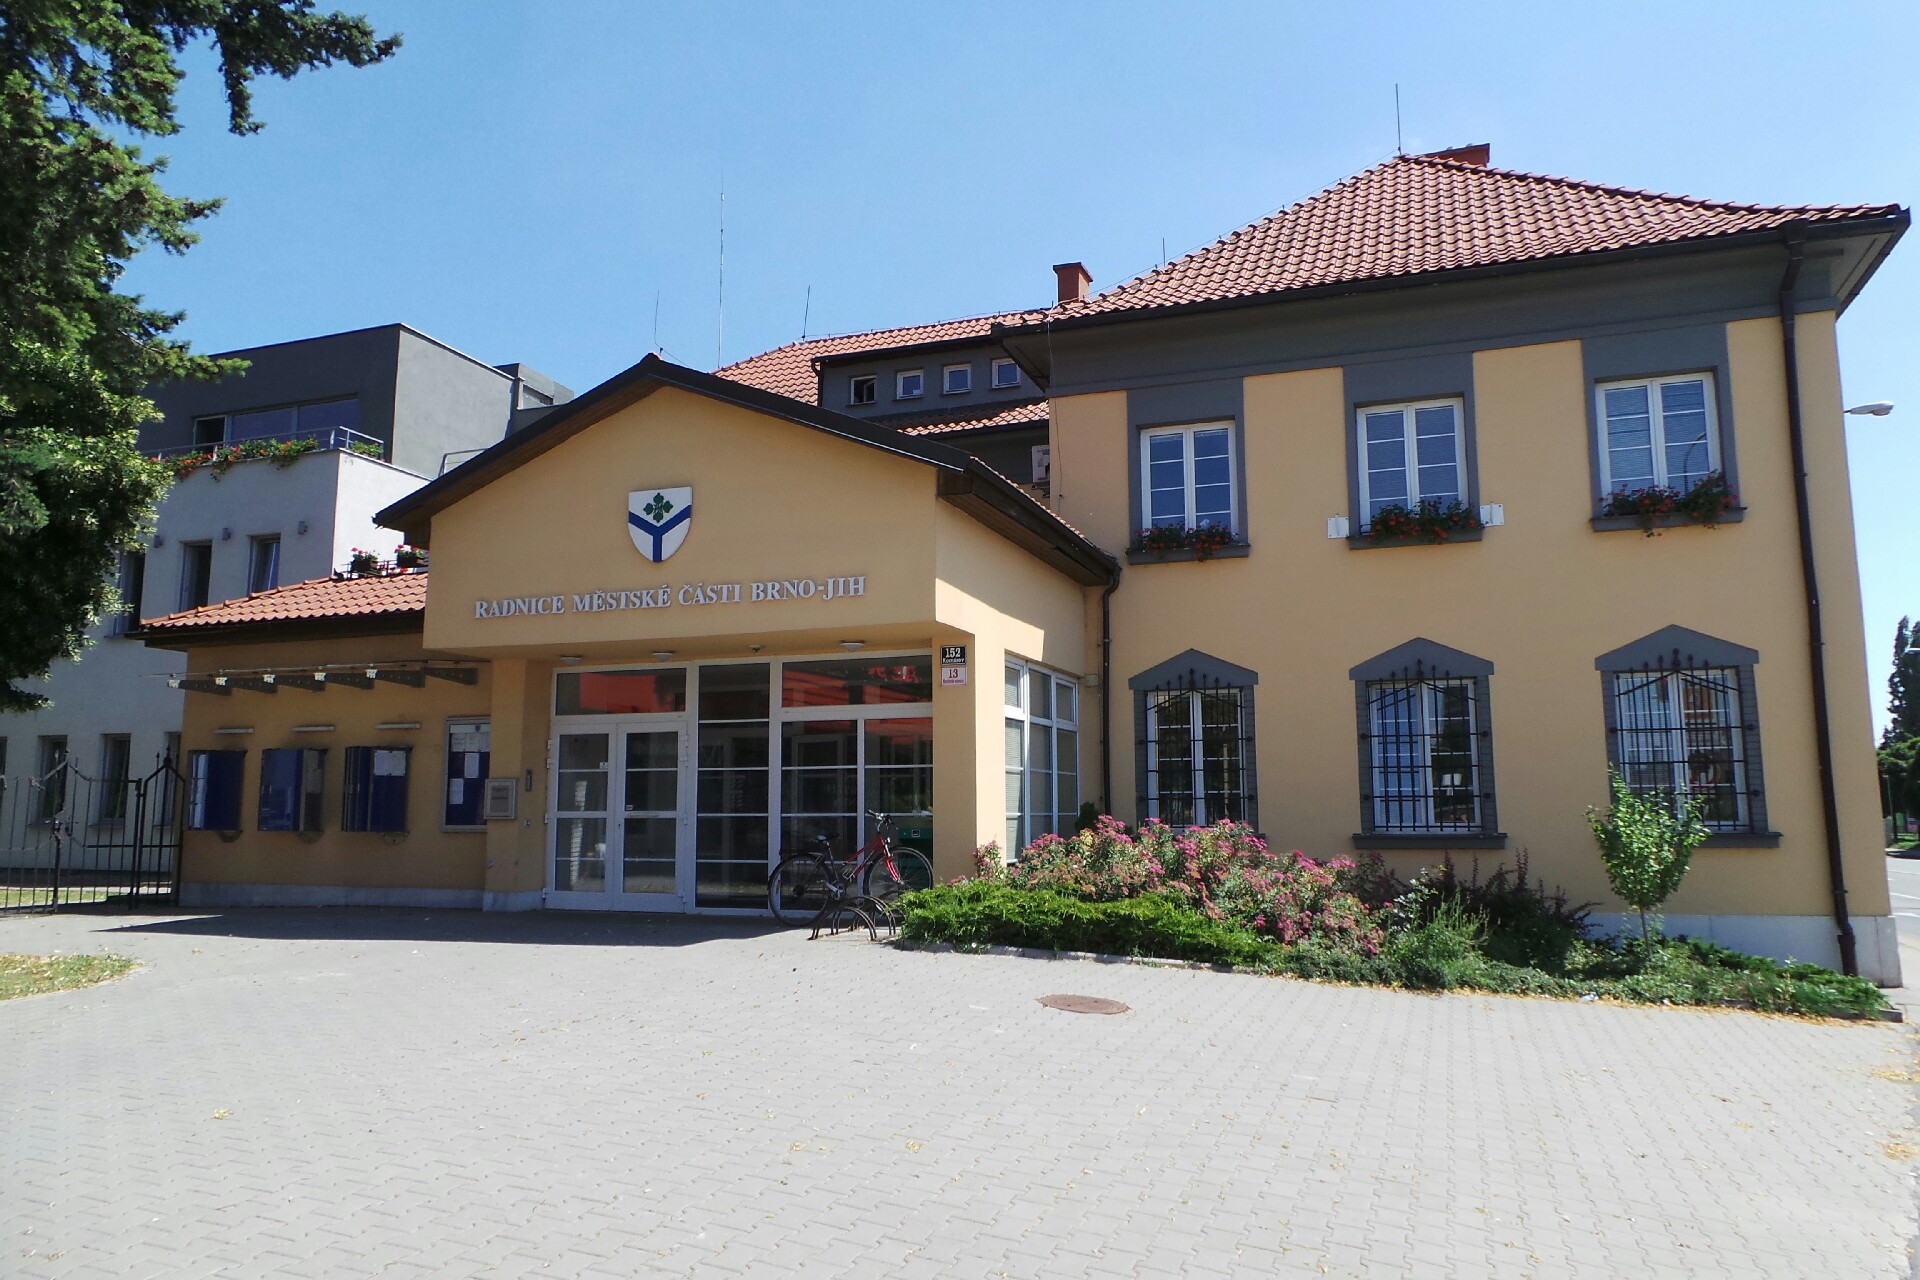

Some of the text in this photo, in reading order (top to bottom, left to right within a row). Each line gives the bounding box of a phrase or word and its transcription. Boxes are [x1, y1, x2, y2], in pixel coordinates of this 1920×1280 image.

[474, 576, 866, 619] RADNICE MĚSTSKÉ ČÁSTI BRNO-JIH
[945, 648, 960, 658] 152
[948, 668, 958, 678] 13
